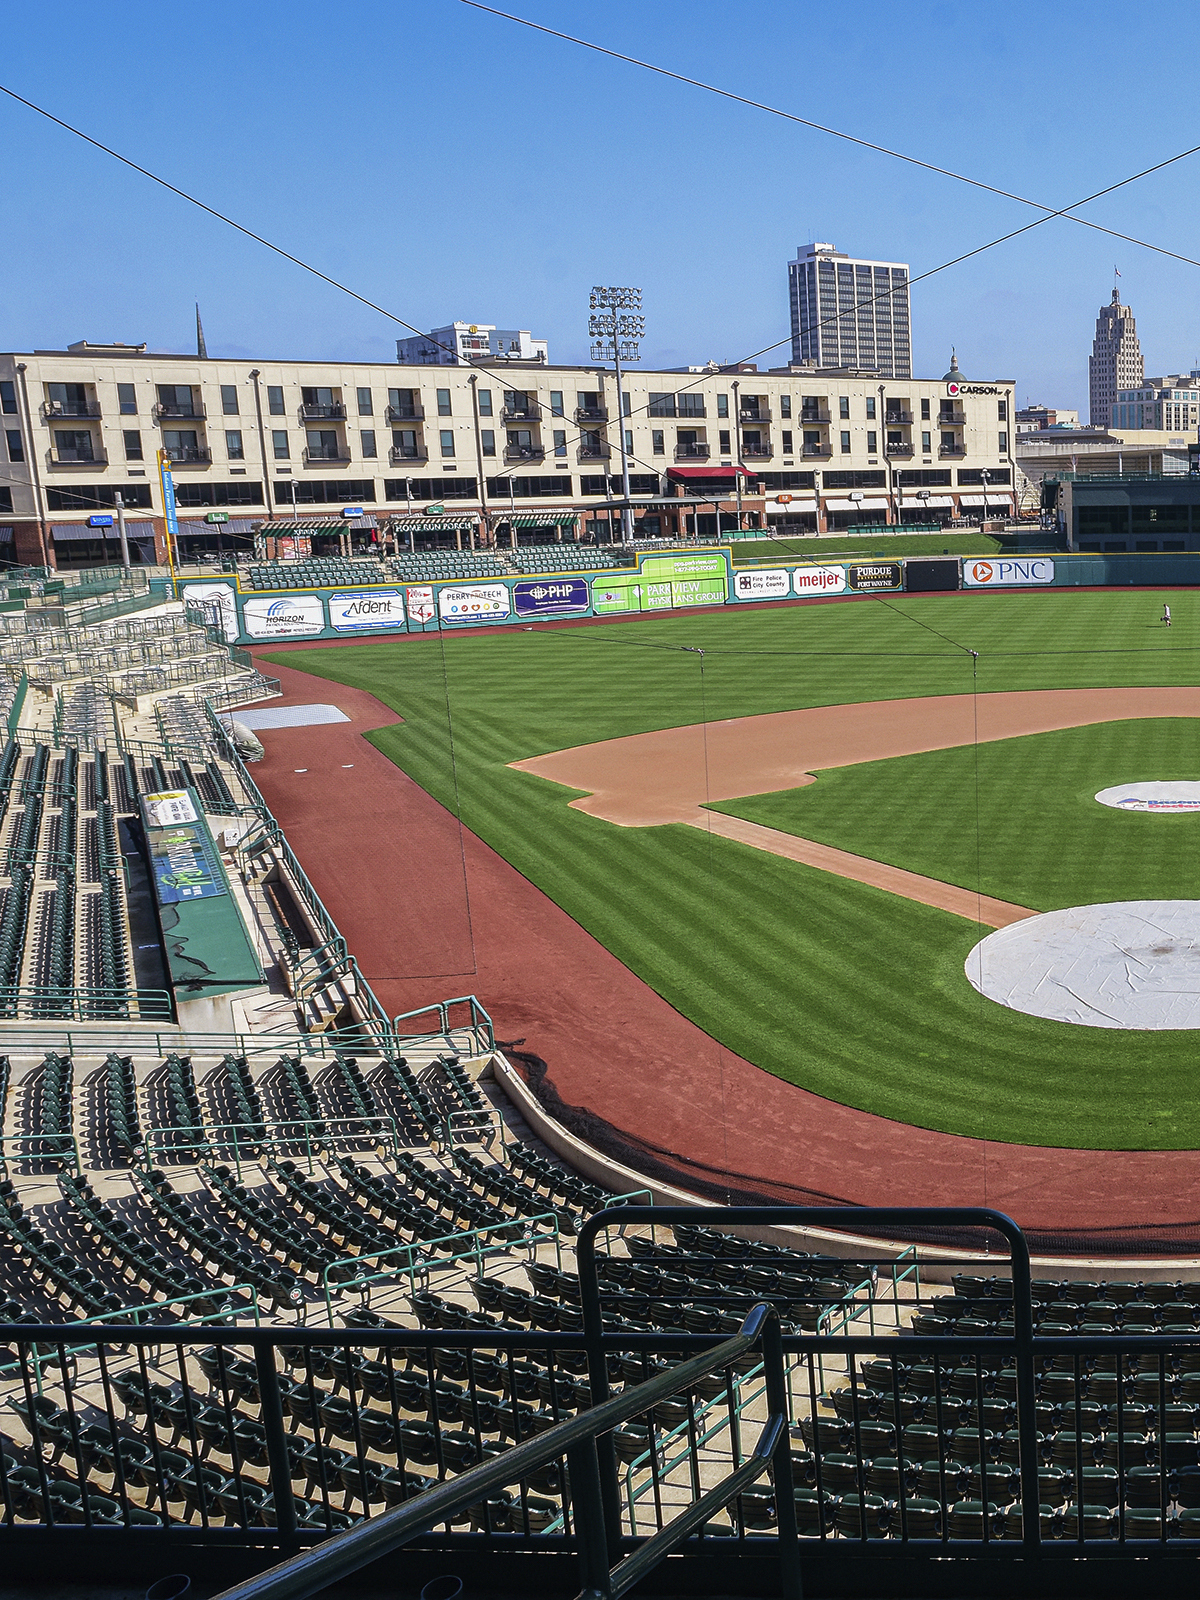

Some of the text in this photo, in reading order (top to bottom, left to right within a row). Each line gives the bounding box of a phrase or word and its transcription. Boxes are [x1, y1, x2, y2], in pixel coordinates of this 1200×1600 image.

[960, 386, 997, 395] CARSON
[396, 521, 471, 532] HOME RUN PORCH
[857, 566, 892, 576] PURDUE
[1000, 562, 1046, 580] PNC
[800, 572, 840, 588] meijer
[549, 584, 573, 598] PHP
[647, 582, 700, 596] PARKVIEW
[696, 592, 724, 601] GROUP
[347, 600, 391, 615] Afdent
[266, 615, 304, 623] HORIZON
